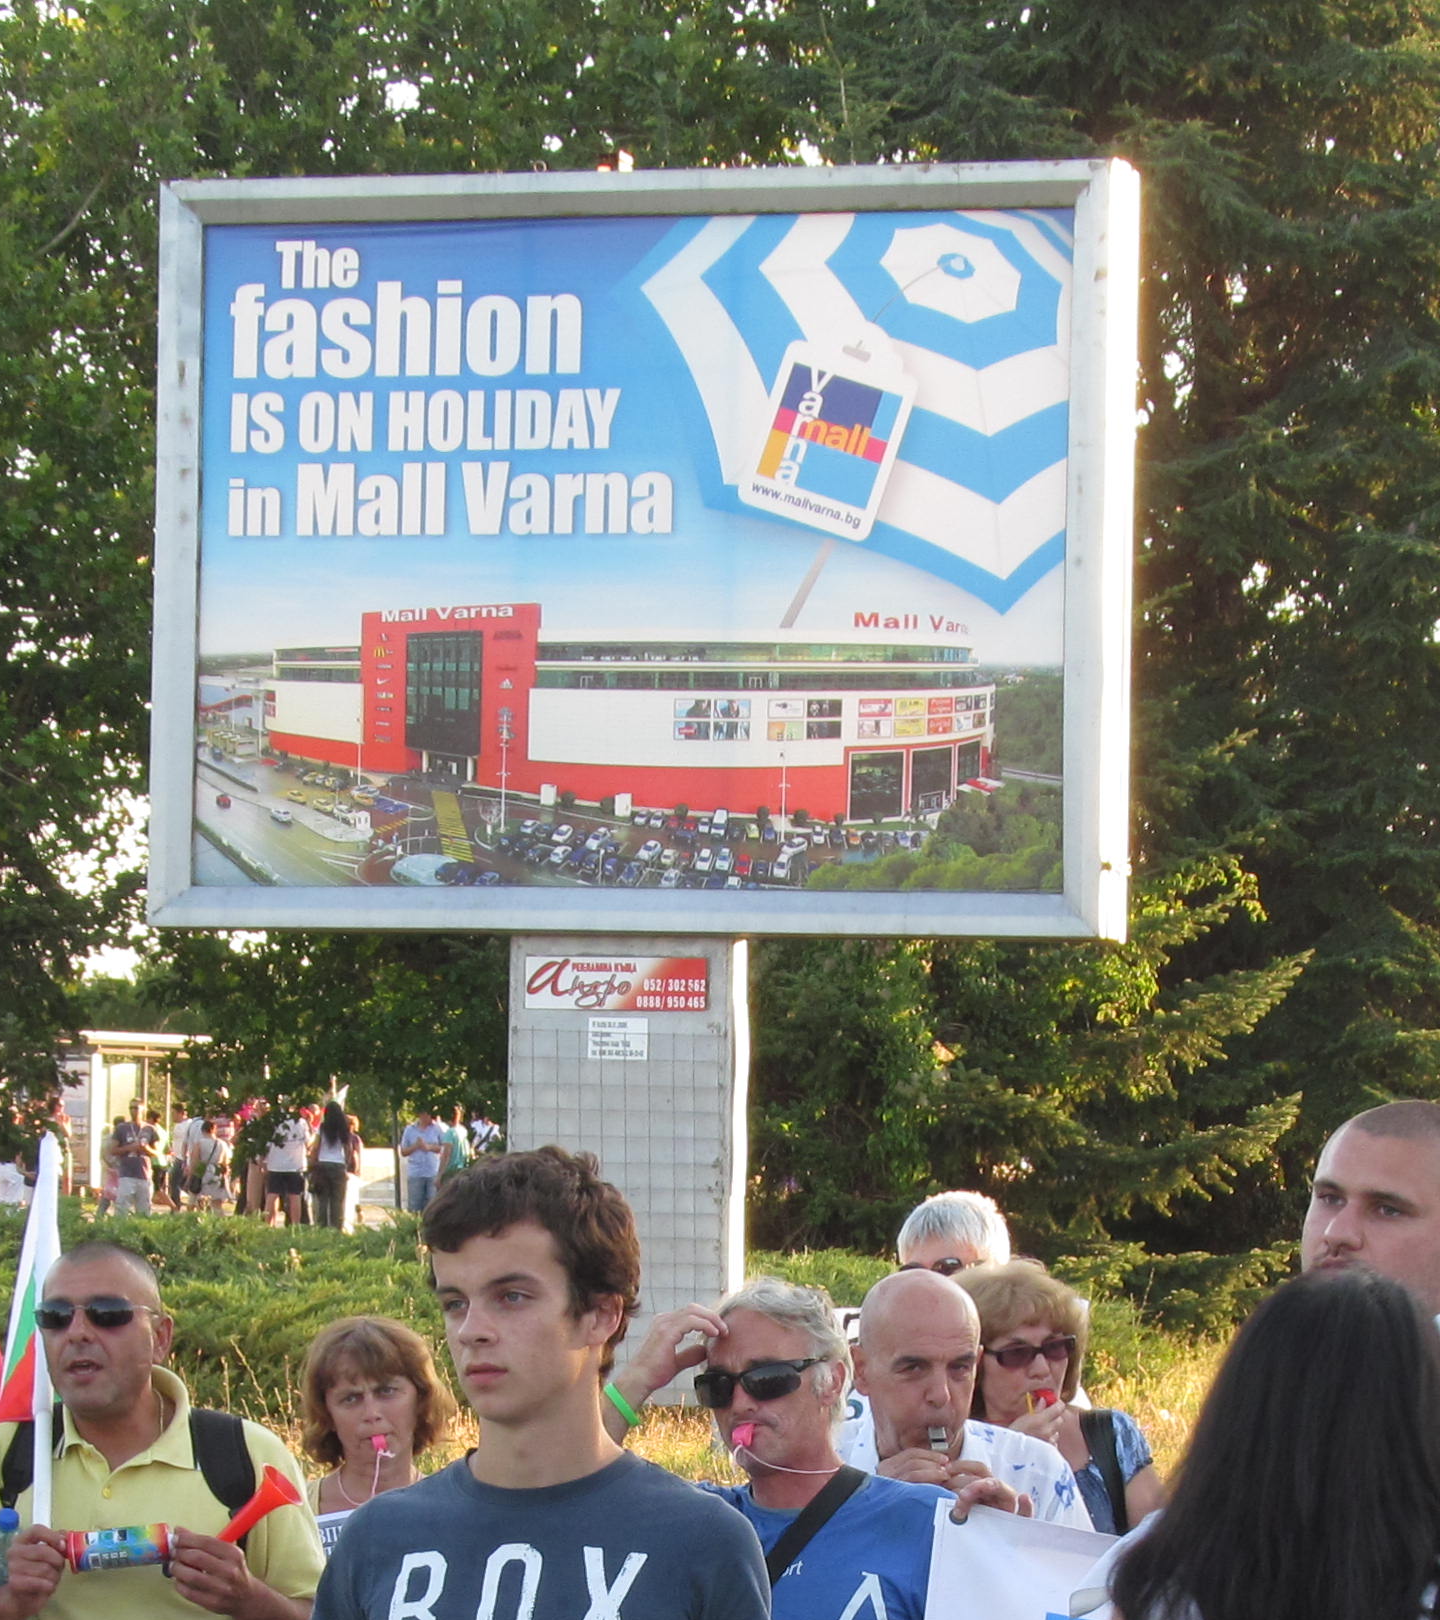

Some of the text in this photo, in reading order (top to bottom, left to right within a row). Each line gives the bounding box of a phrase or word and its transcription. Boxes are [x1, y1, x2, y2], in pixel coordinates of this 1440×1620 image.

[276, 240, 360, 290] The
[230, 279, 583, 380] fashion
[230, 387, 622, 454] IS ON HOLIDAY
[802, 418, 873, 459] mall
[227, 460, 674, 537] in Mall Varna
[751, 482, 862, 529] www.mallvarna.bg
[381, 605, 514, 622] Mall Varna
[854, 611, 919, 630] Mall
